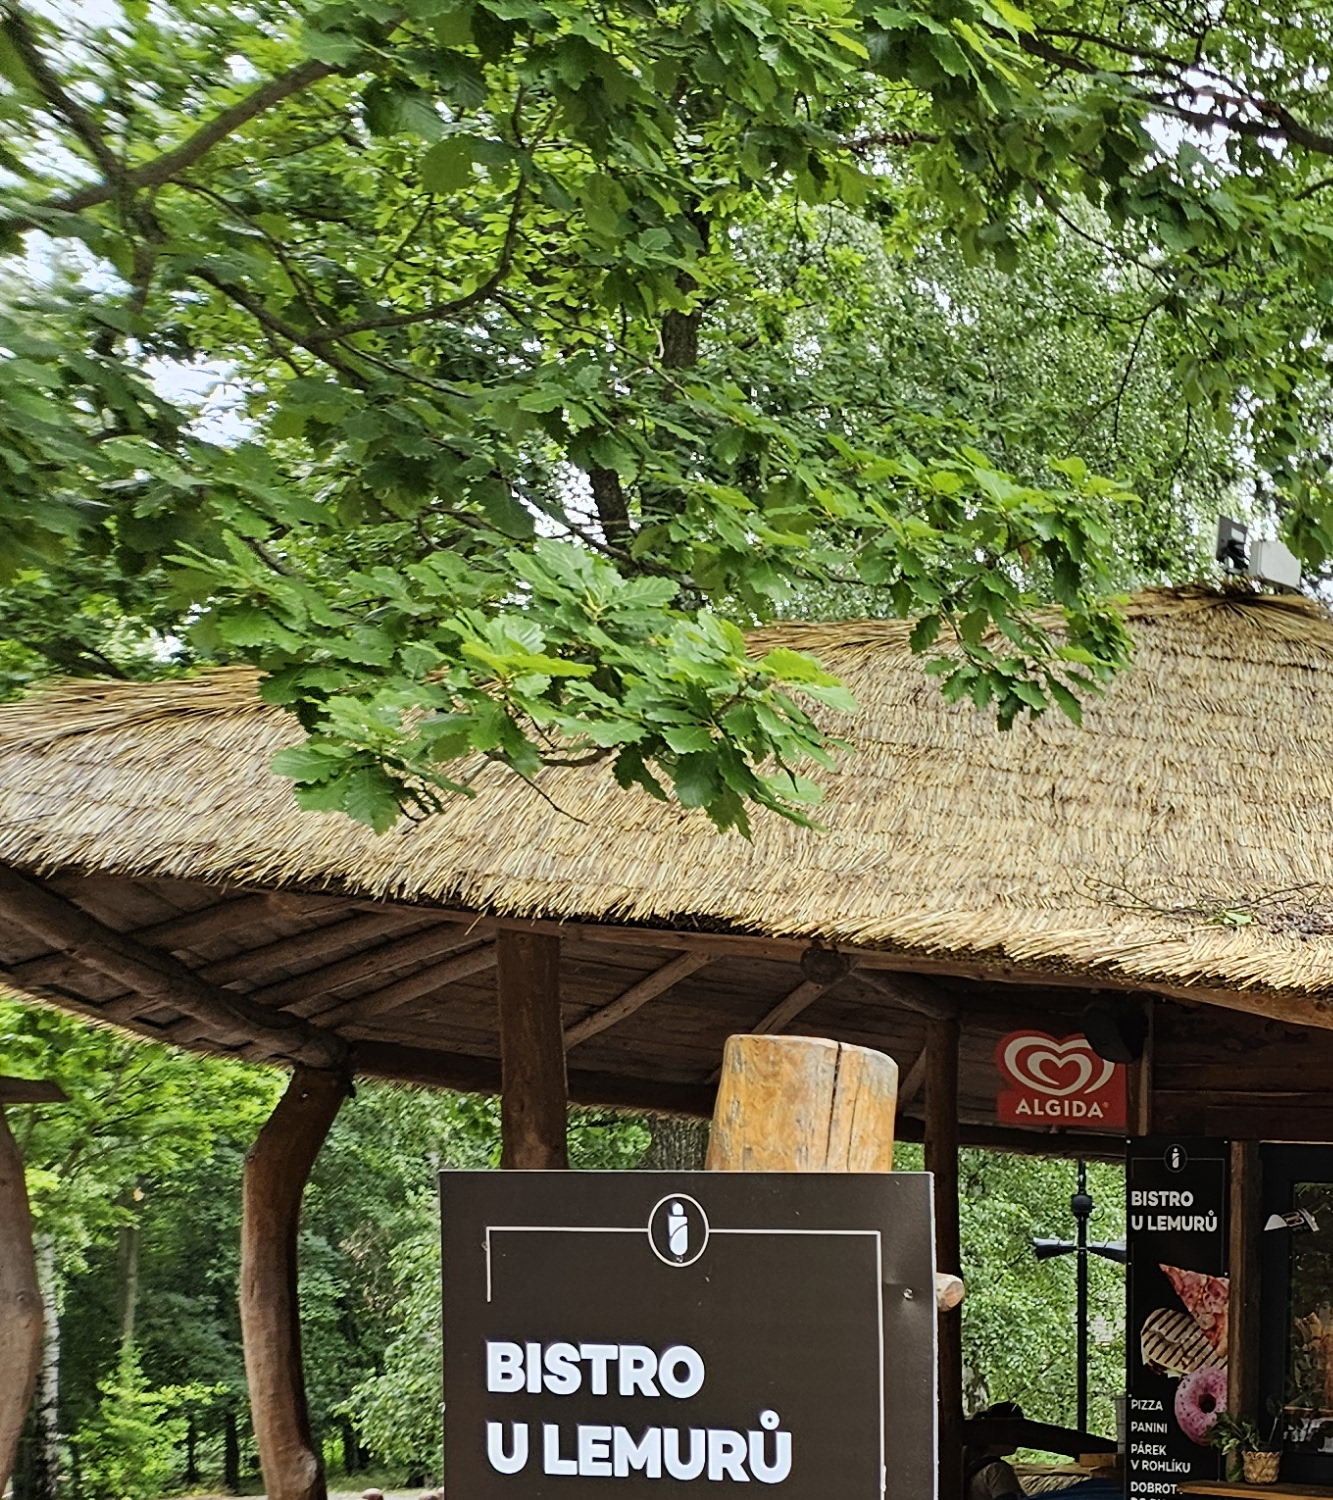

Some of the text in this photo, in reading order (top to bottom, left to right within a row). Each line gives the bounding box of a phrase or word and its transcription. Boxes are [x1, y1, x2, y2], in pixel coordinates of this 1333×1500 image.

[1015, 1098, 1104, 1118] ALGIDA
[1131, 1190, 1194, 1207] BISTRO
[1131, 1209, 1218, 1232] U LEMURŮ
[487, 1341, 705, 1399] BISTRO
[1131, 1399, 1163, 1411] PIZZA
[1131, 1421, 1168, 1434] PANINI
[487, 1410, 792, 1484] U LEMURŮ
[1130, 1441, 1167, 1456] PÁREK
[1130, 1458, 1191, 1473] V ROHLÍKU
[1130, 1481, 1183, 1495] DOBROT
